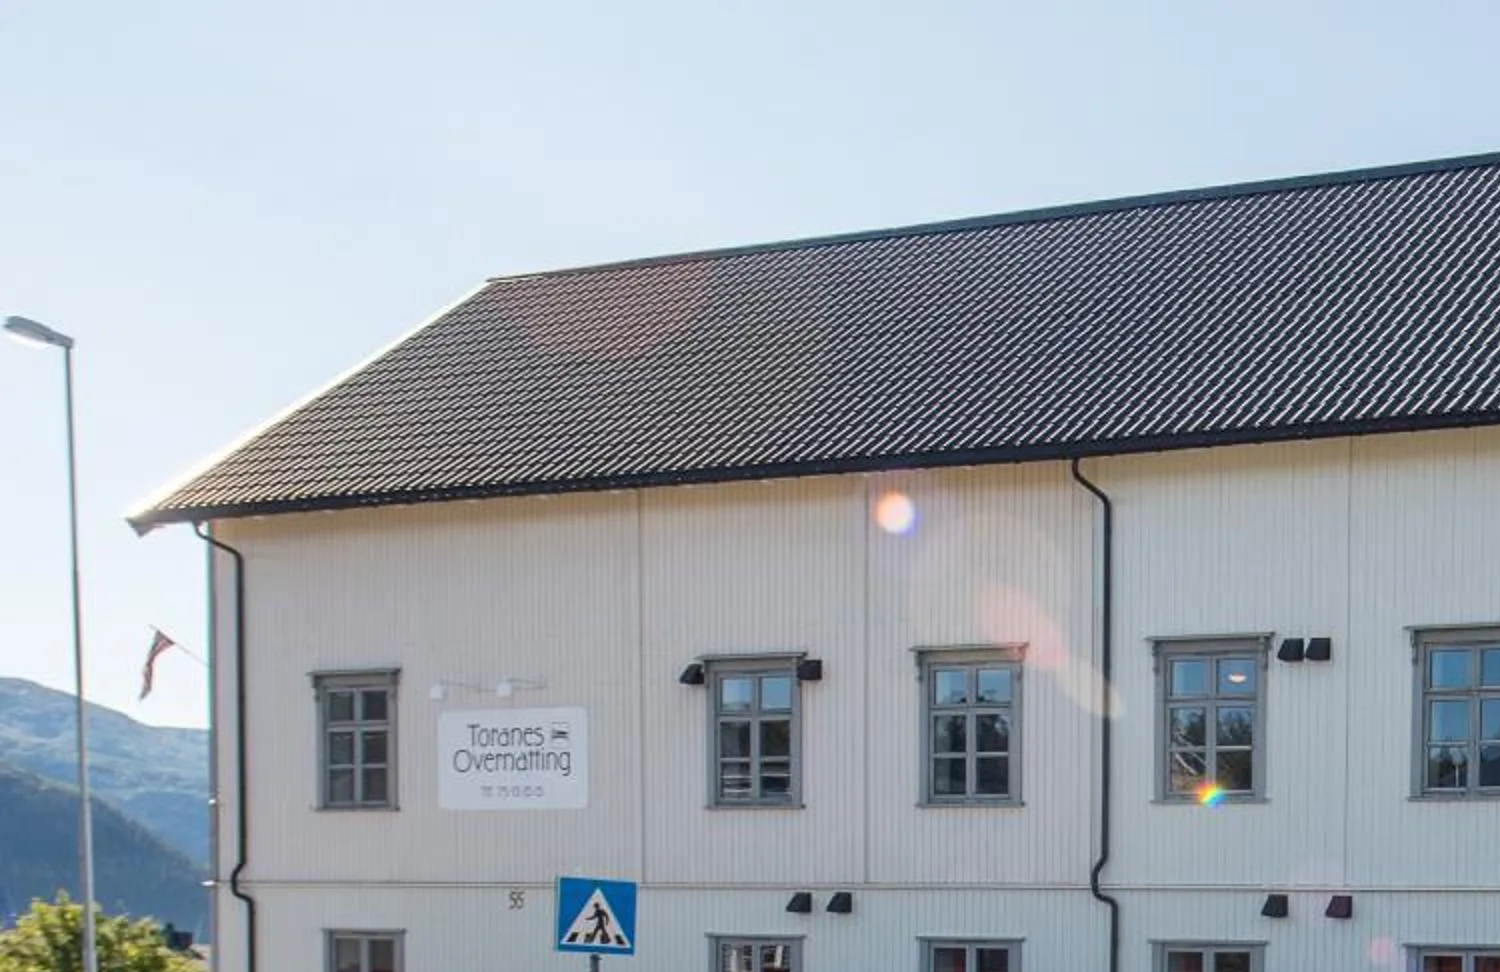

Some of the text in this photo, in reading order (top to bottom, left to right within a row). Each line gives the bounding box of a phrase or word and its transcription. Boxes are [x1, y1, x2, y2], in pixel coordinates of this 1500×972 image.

[466, 723, 545, 748] Toranes
[453, 748, 572, 777] Overnatting
[509, 891, 525, 910] 55
